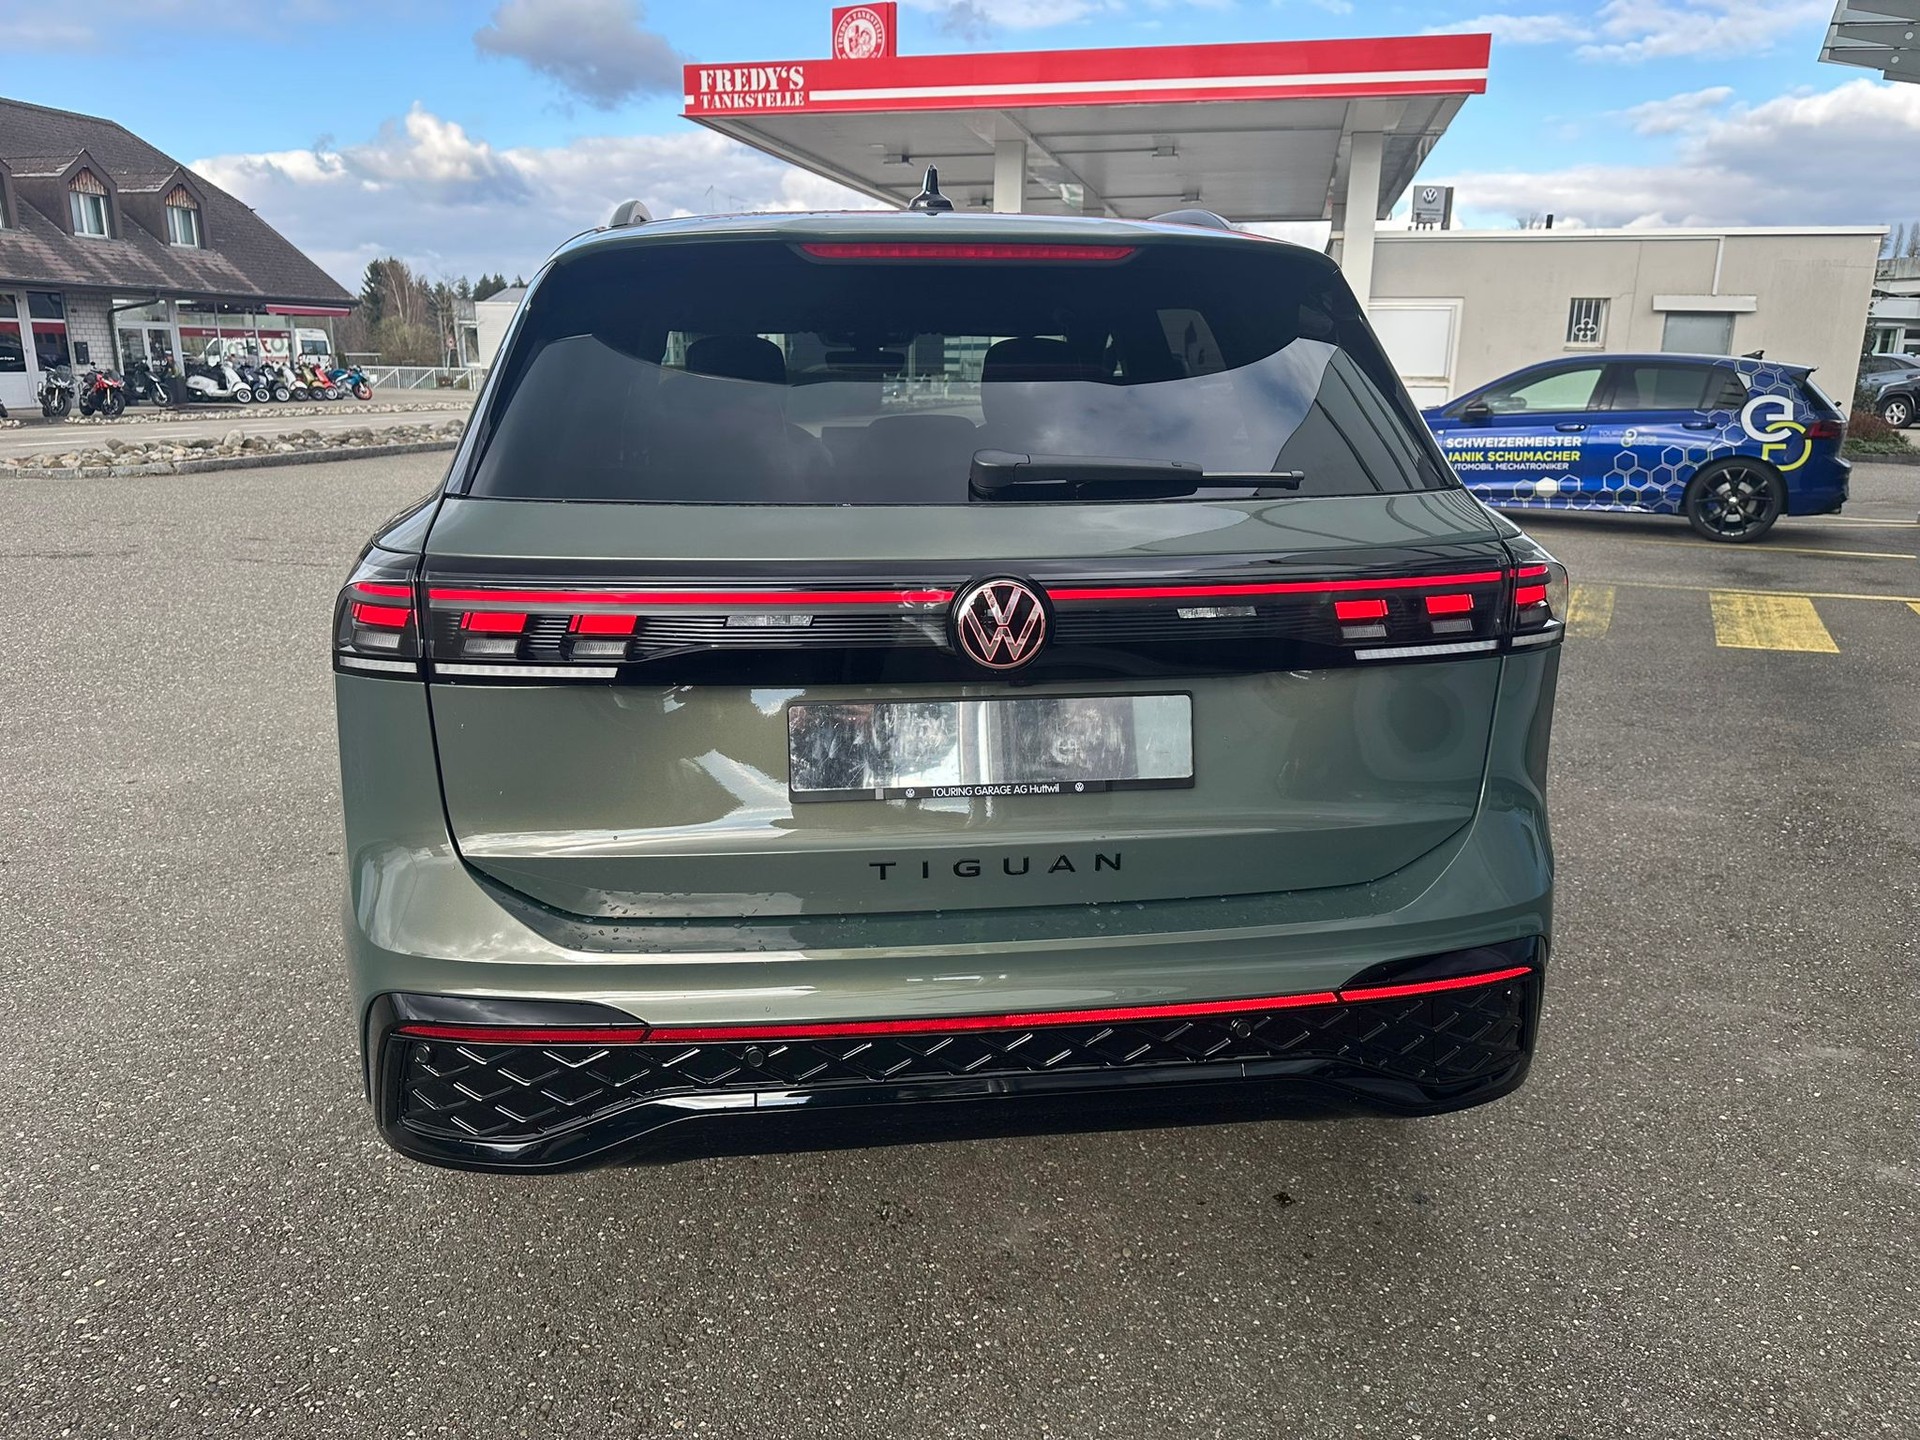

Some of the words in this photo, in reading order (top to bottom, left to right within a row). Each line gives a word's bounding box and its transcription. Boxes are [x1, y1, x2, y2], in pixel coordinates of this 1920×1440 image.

[700, 91, 804, 109] TANKSTELLE
[1446, 436, 1582, 448] SCHWEIZERMEISTER
[1487, 451, 1581, 462] SCHUMACHER
[1495, 462, 1569, 470] MECHATRONIKER
[931, 786, 973, 797] TOURING
[974, 785, 1012, 796] GARAGE
[1013, 784, 1028, 795] AG
[1029, 783, 1060, 794] Huttwil
[869, 853, 1122, 881] TIGUAN
